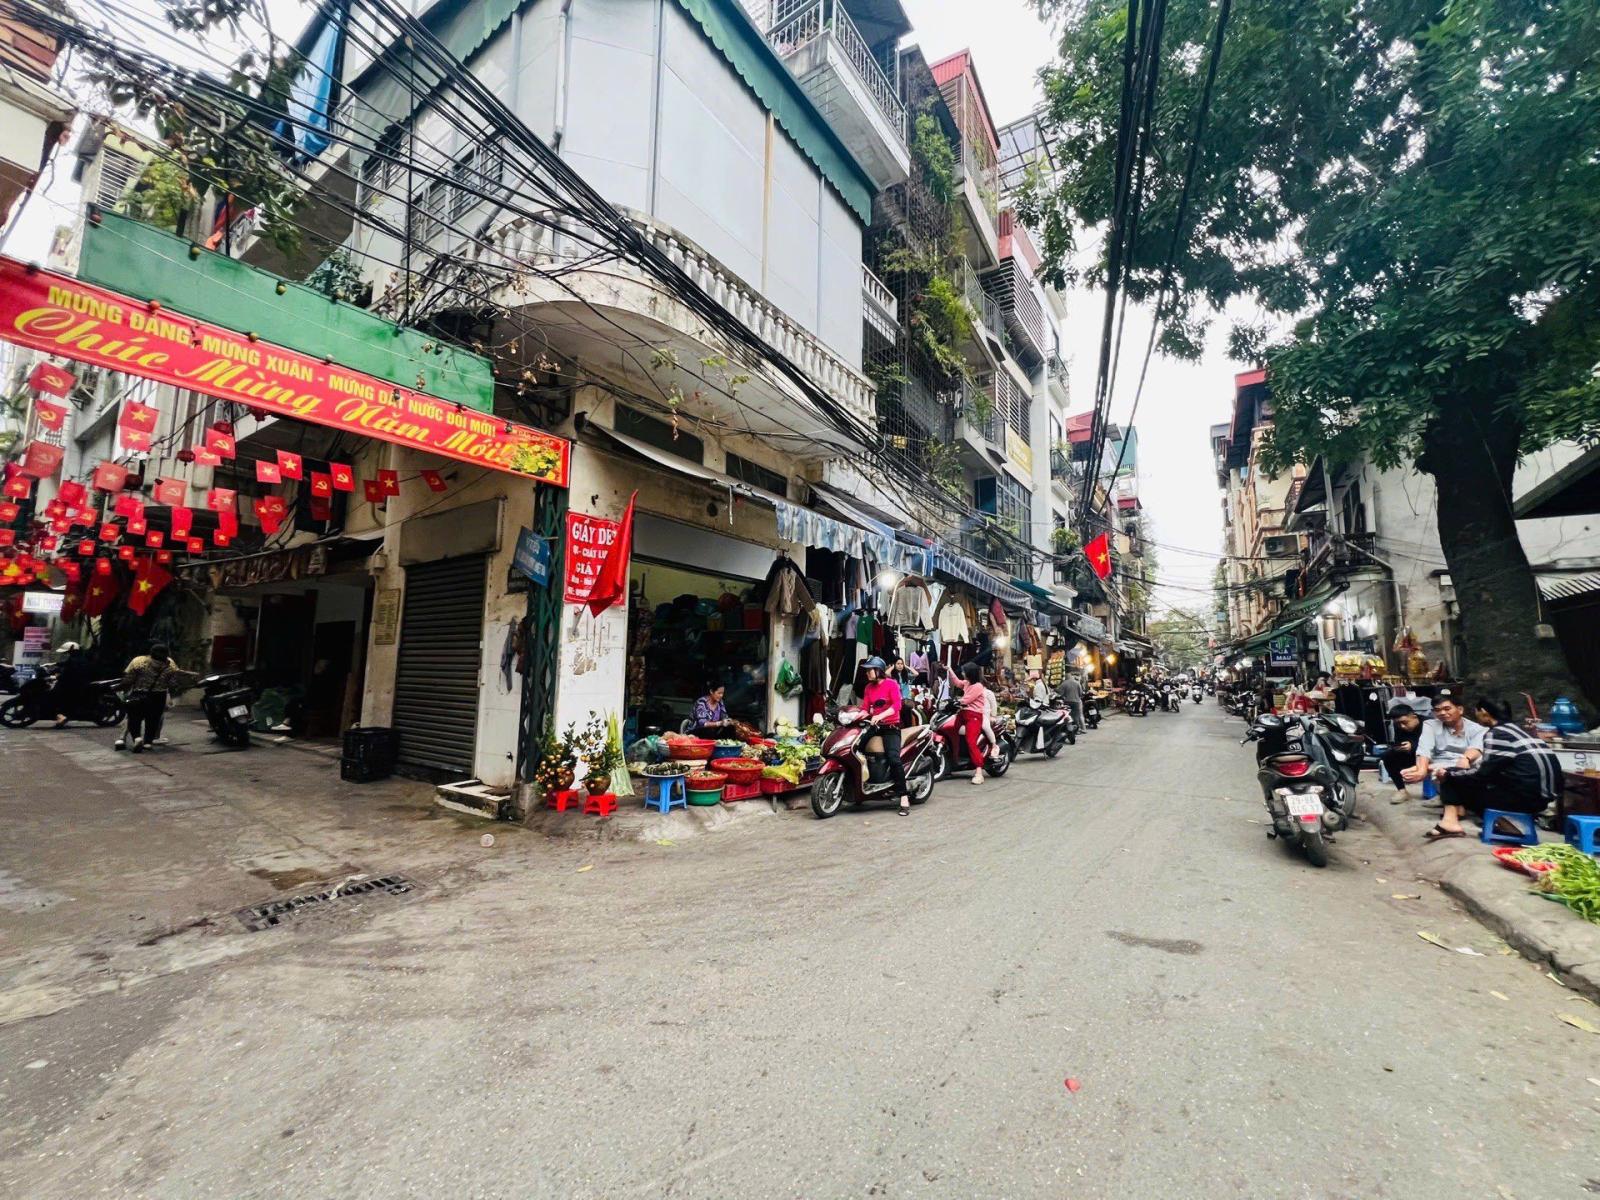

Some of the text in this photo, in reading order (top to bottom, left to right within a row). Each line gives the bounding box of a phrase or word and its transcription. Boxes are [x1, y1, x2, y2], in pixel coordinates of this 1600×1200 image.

[14, 308, 169, 369] Chúc
[174, 359, 322, 415] Mừng
[335, 398, 430, 442] Năm
[265, 354, 313, 383] XUÂN
